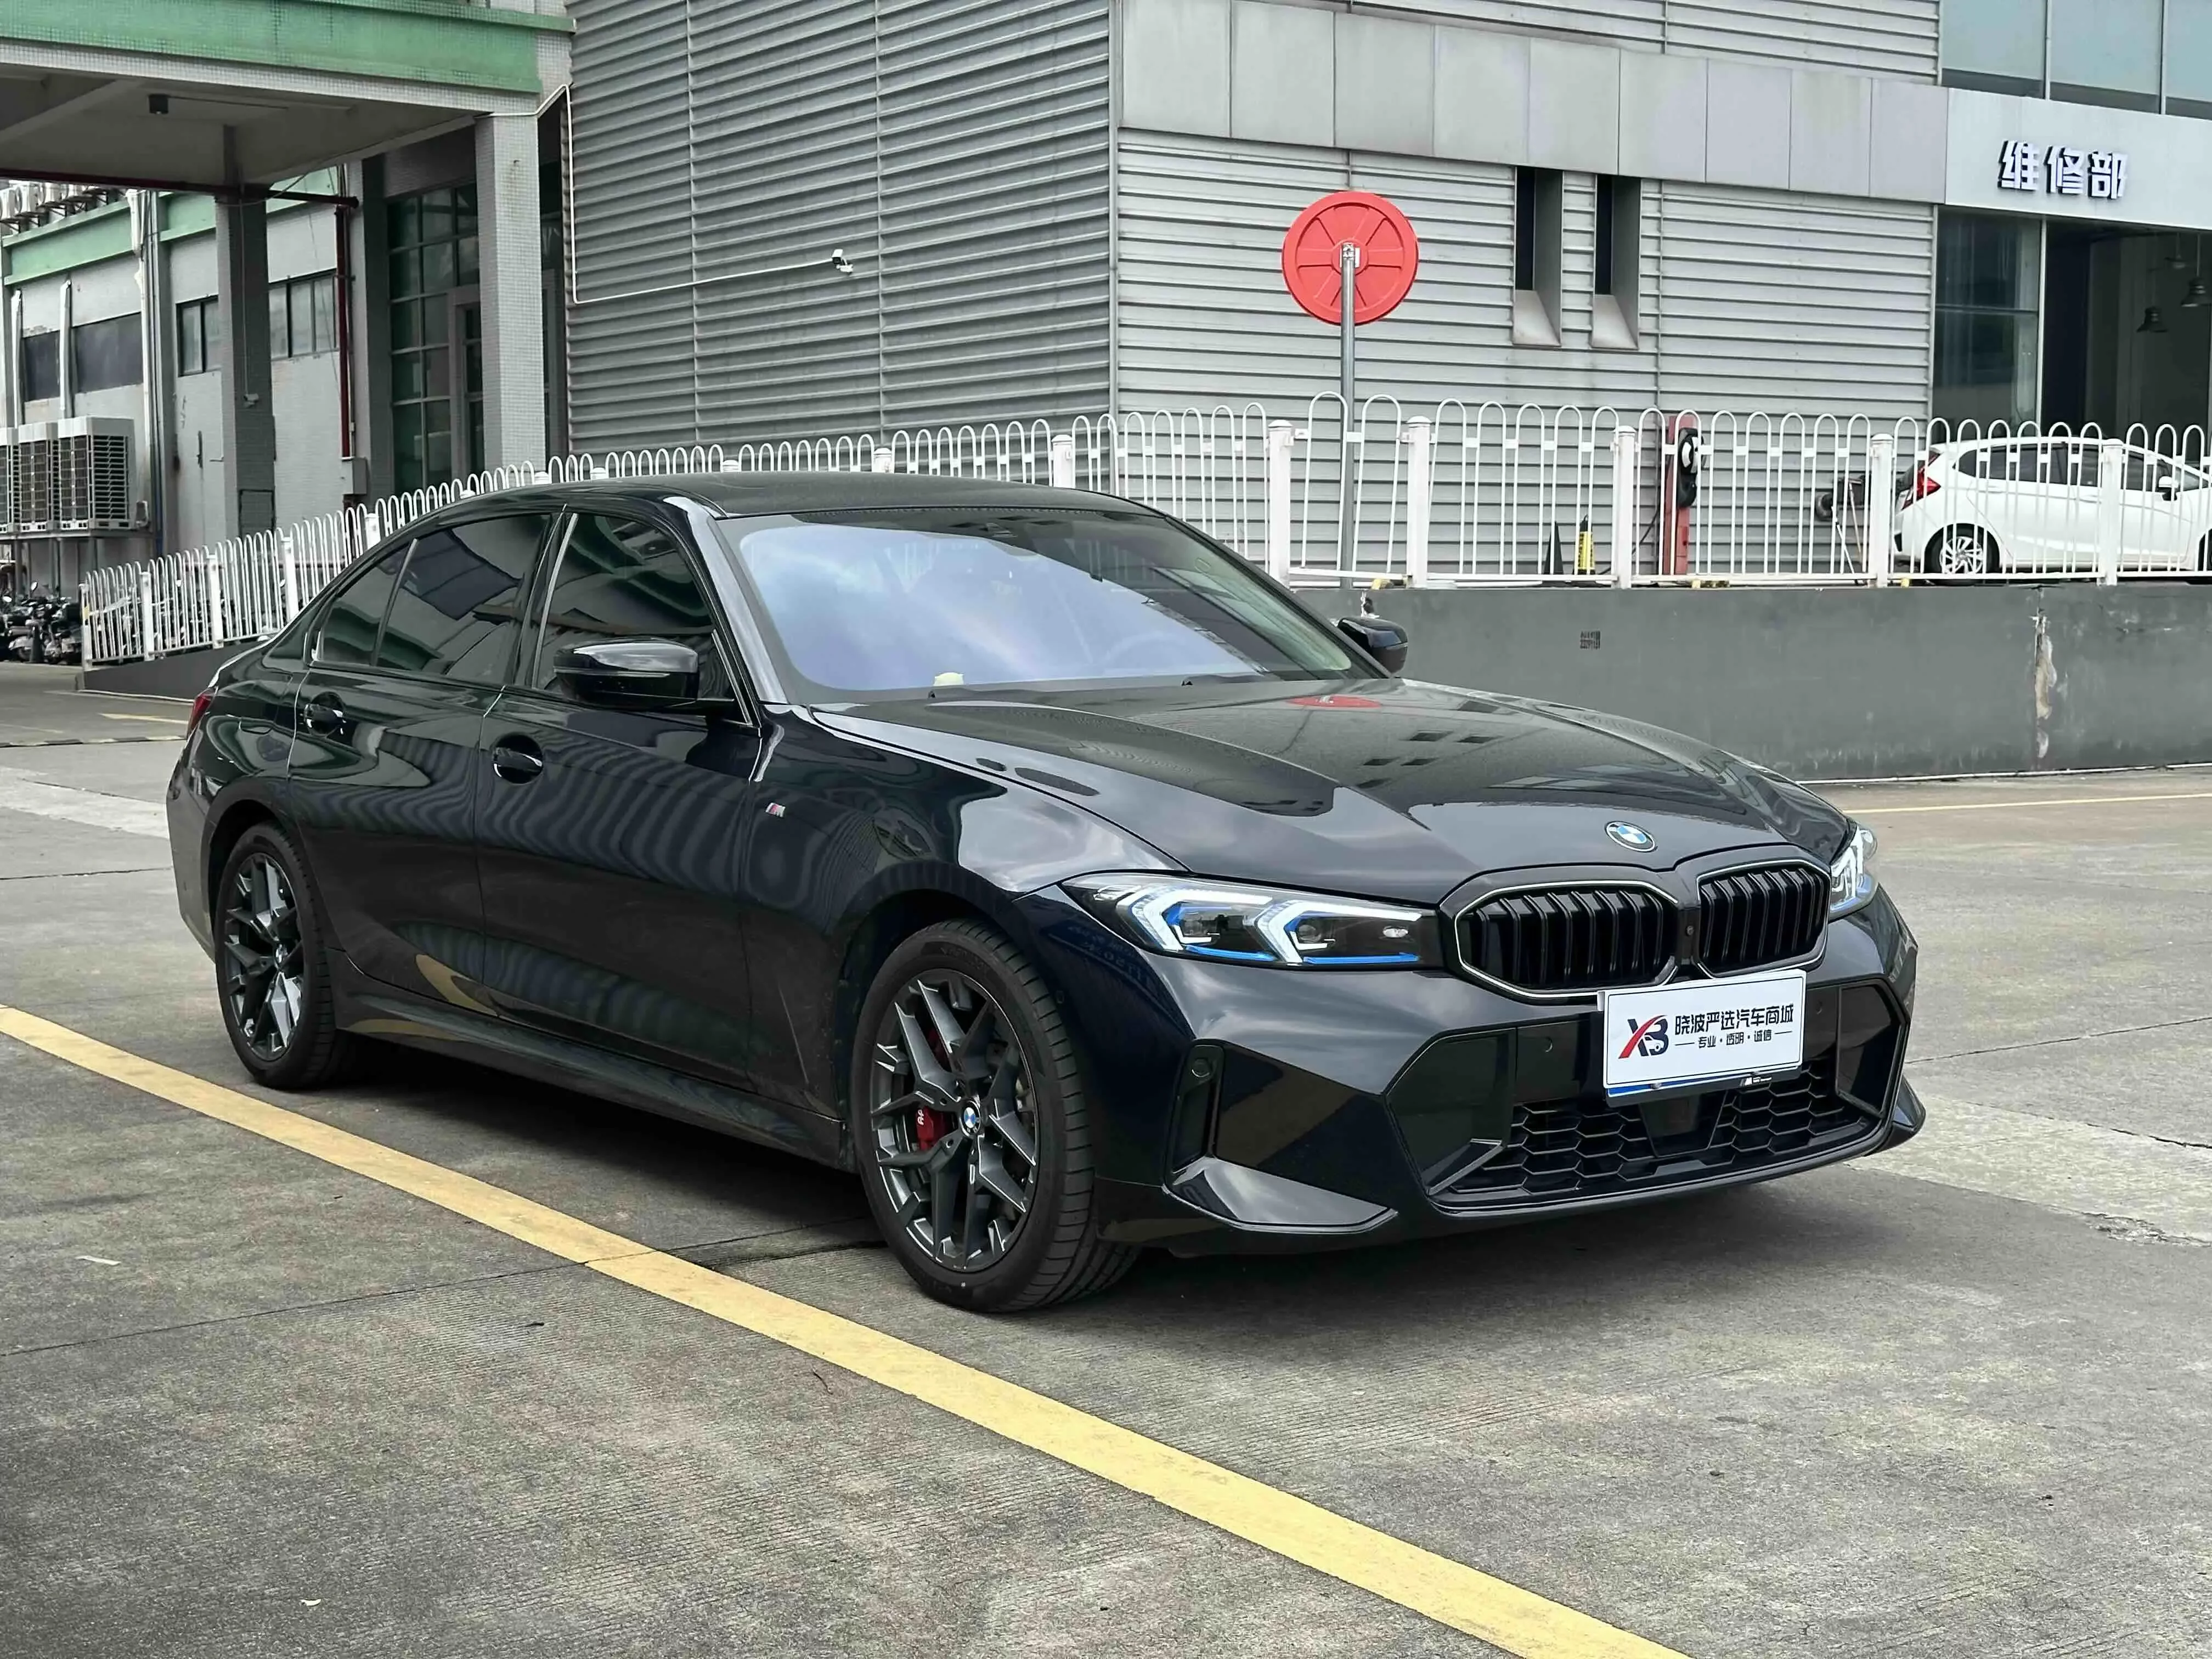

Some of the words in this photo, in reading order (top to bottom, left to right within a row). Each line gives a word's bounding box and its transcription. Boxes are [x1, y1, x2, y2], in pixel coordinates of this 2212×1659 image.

[1997, 139, 2128, 199] 维修部
[1675, 1003, 1793, 1035] 晓波严选汽车商城
